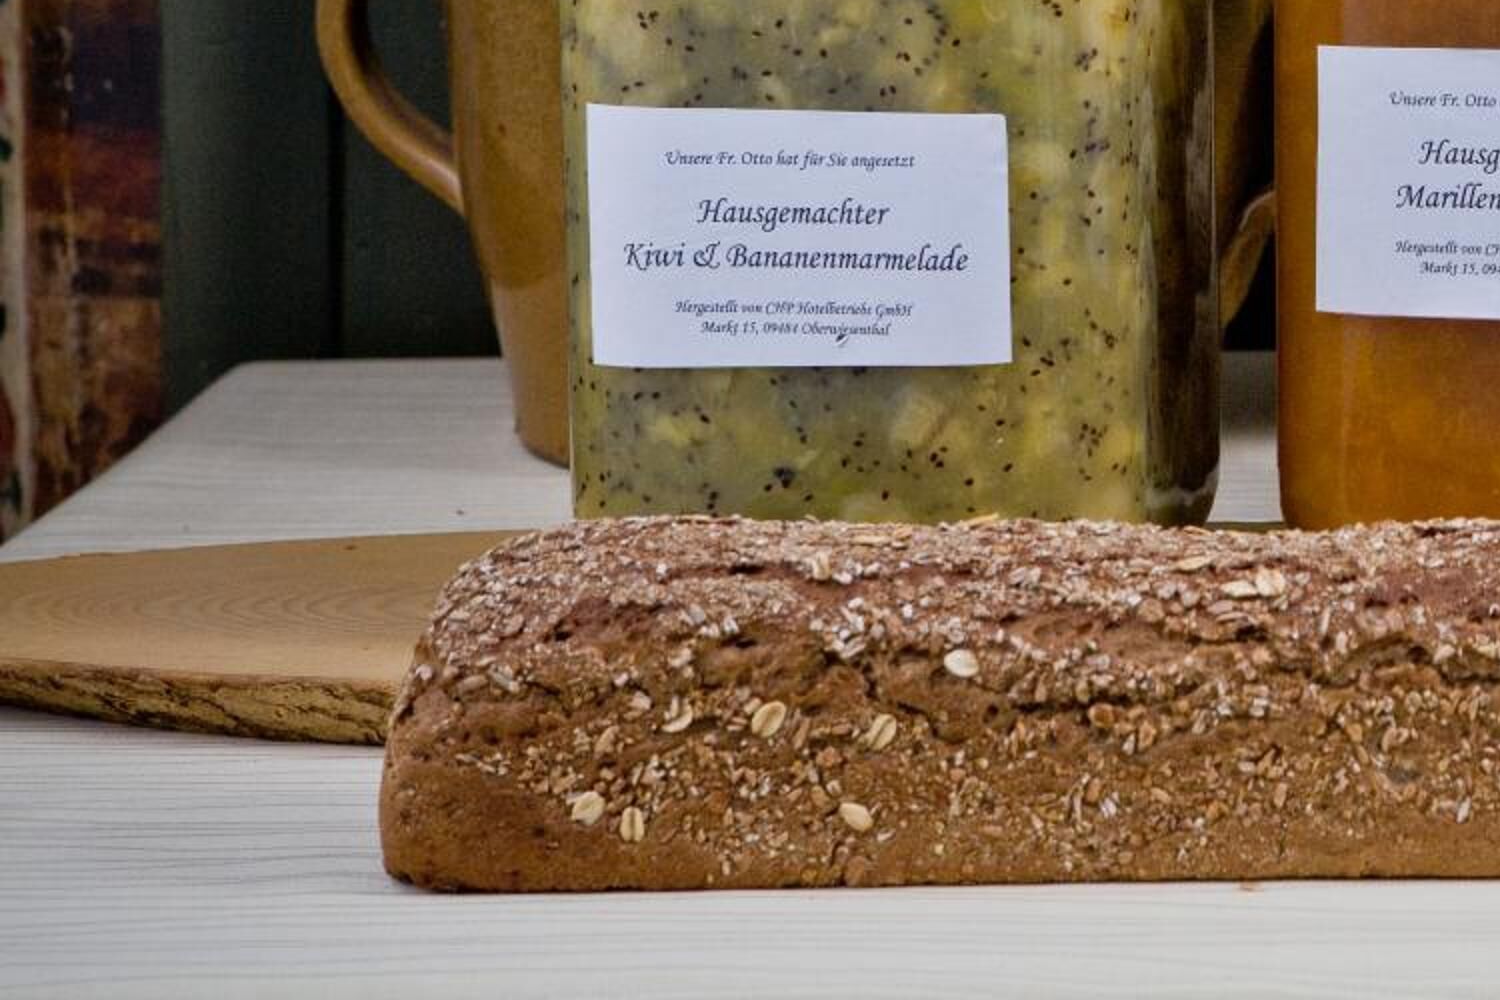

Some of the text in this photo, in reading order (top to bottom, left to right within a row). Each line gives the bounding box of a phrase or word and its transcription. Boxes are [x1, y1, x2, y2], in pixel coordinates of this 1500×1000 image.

[1390, 91, 1436, 106] Unsere
[1440, 94, 1459, 106] Fr.
[1465, 94, 1496, 107] Otto
[664, 151, 915, 171] Unsere Fr. Otto hat für Sie angesetzt
[696, 197, 890, 232] Hausgemachter
[624, 242, 968, 271] Kiwi & Bananenmarmelade
[1420, 262, 1458, 276] Markt
[1462, 263, 1478, 275] 15,
[701, 320, 738, 336] Markt
[743, 322, 758, 335] 15,
